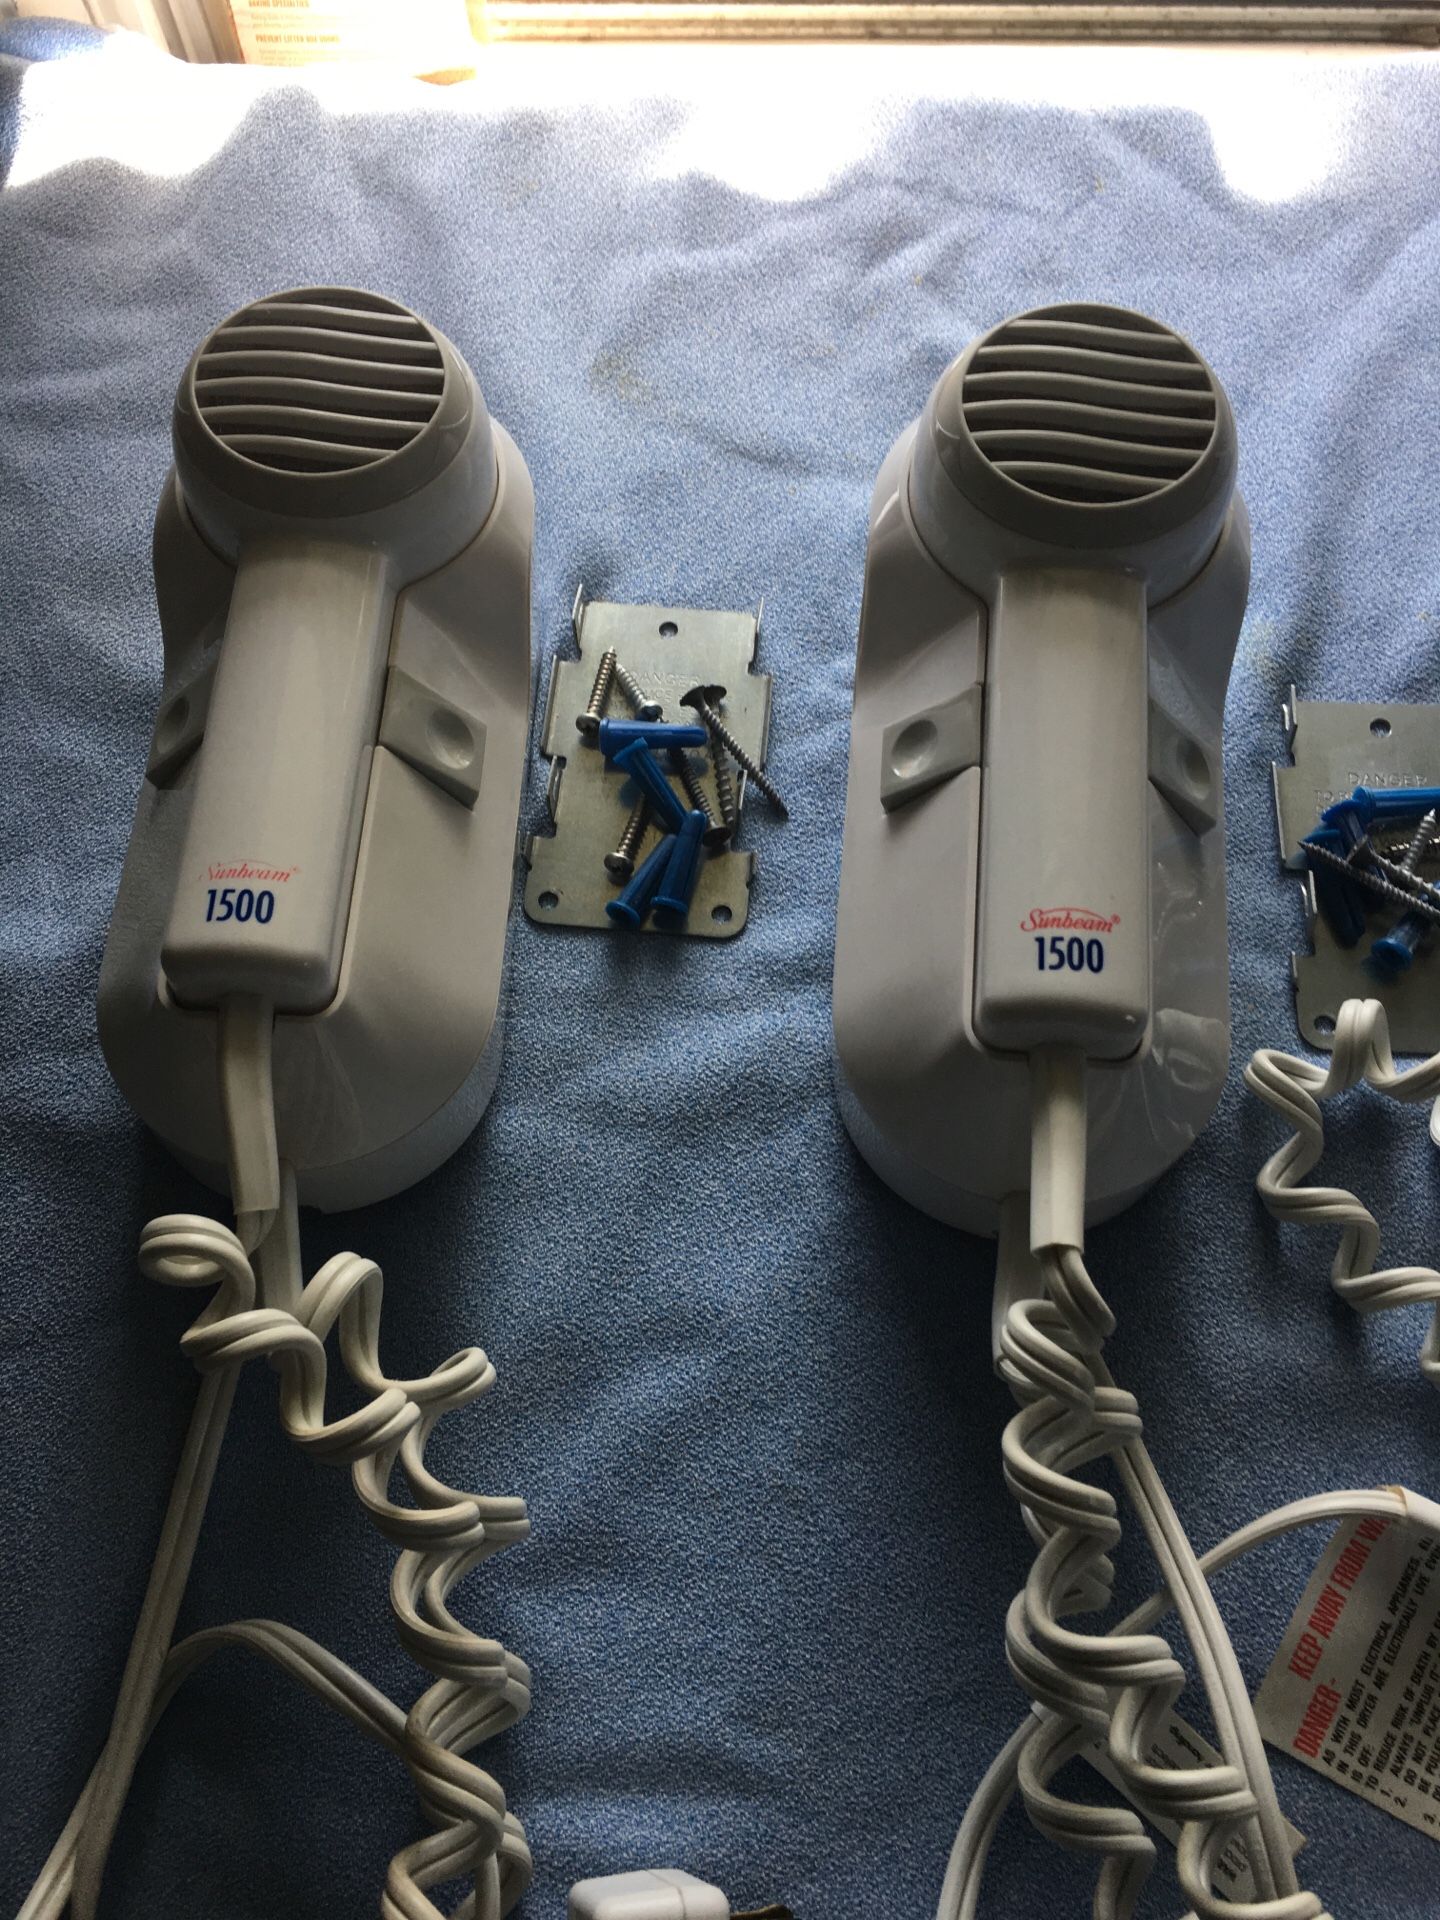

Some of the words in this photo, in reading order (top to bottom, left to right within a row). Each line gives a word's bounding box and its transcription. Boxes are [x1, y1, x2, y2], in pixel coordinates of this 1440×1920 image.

[255, 33, 282, 43] PREVENT
[1347, 771, 1428, 789] DANGER
[206, 888, 275, 925] 1500
[1034, 936, 1104, 974] 1500
[1288, 1632, 1322, 1680] KEEP
[1308, 1583, 1346, 1639] AWAY
[1330, 1538, 1372, 1591] FROM
[1322, 1748, 1336, 1766] AS
[1330, 1714, 1351, 1744] WITH
[1345, 1679, 1366, 1712] MOST
[1360, 1620, 1393, 1677] ELECTRICAL
[1336, 1759, 1349, 1775] IN
[1343, 1731, 1362, 1756] THIS
[1356, 1693, 1379, 1729] DRYER
[1373, 1667, 1391, 1690] ARE
[1382, 1597, 1419, 1667] ELECTRICALLY
[1413, 1573, 1431, 1597] LIVE
[1365, 1775, 1379, 1791] TO
[1373, 1730, 1397, 1773] REDUCE
[1391, 1703, 1409, 1730] RISK
[1403, 1686, 1416, 1702] OF
[1410, 1650, 1431, 1686] DEATH
[1425, 1632, 1438, 1649] BY
[1350, 1769, 1363, 1783] IS
[1380, 1788, 1393, 1798] 1.
[1390, 1732, 1414, 1777] ALWAYS
[1393, 1796, 1407, 1808] 2.
[1403, 1768, 1418, 1786] DO
[1412, 1741, 1428, 1765] NOT
[1418, 1777, 1431, 1794] BE
[1423, 1813, 1437, 1825] 3.
